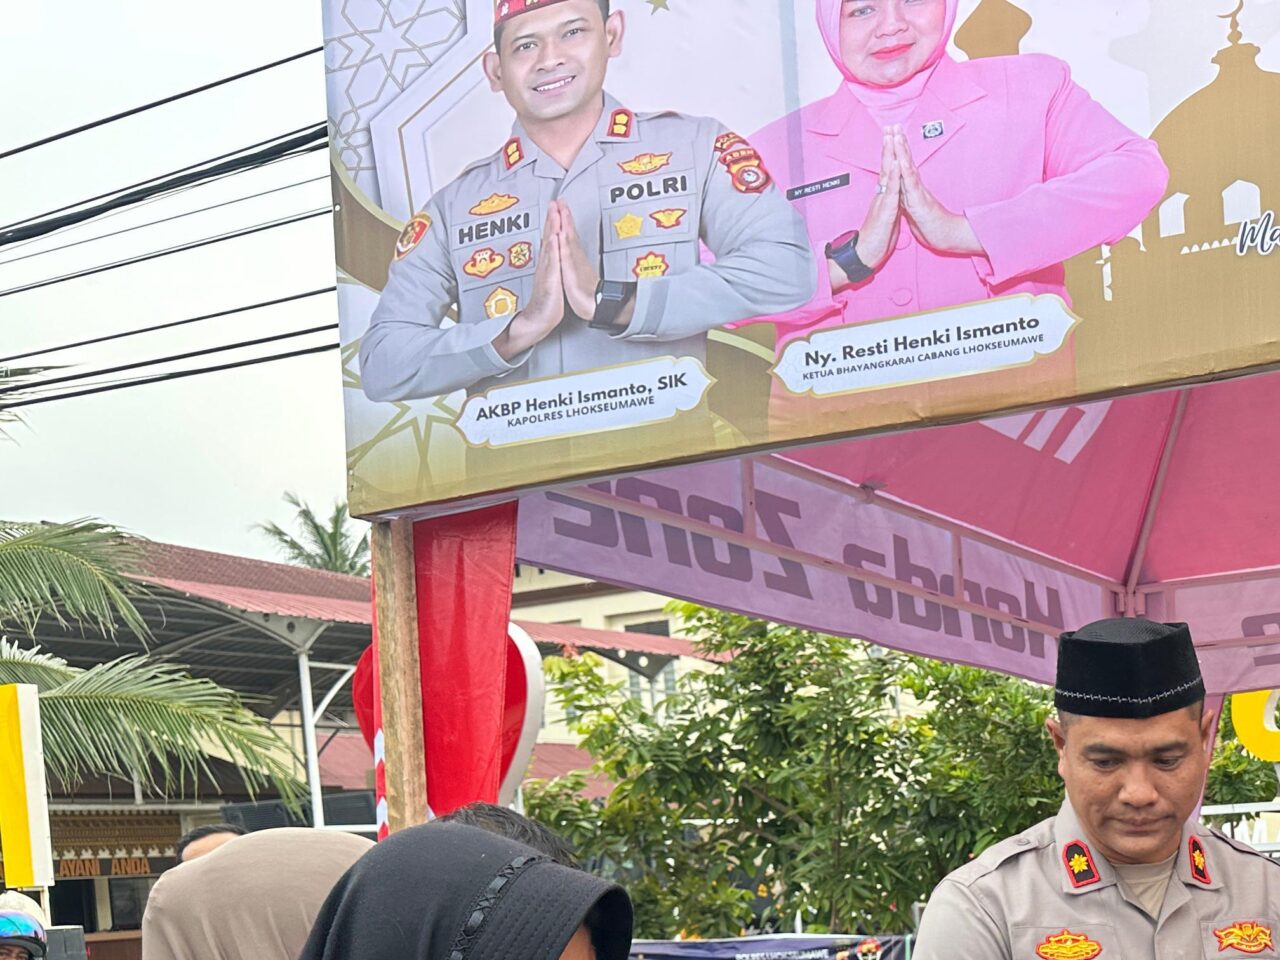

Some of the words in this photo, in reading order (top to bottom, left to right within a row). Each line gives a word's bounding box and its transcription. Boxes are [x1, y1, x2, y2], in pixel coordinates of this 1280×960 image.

[609, 175, 688, 204] POLRI
[458, 213, 531, 245] HENKI
[802, 369, 835, 381] KETUA
[836, 356, 915, 375] BHAYANGKARAI
[917, 348, 960, 362] CABANG
[962, 333, 1045, 355] LHOKSEUMAWE
[804, 351, 837, 369] Ny.
[842, 339, 888, 360] Resti
[894, 327, 951, 351] Henki
[956, 317, 1040, 341] Ismanto
[475, 402, 521, 422] AKBP
[526, 391, 574, 413] Henki
[578, 382, 653, 404] Ismanto,
[657, 372, 688, 391] SIK
[507, 411, 563, 428] KAPOLRES
[566, 396, 655, 419] LHOKSEUMAWE
[57, 858, 101, 877] AYANI
[111, 857, 151, 876] ANDA
